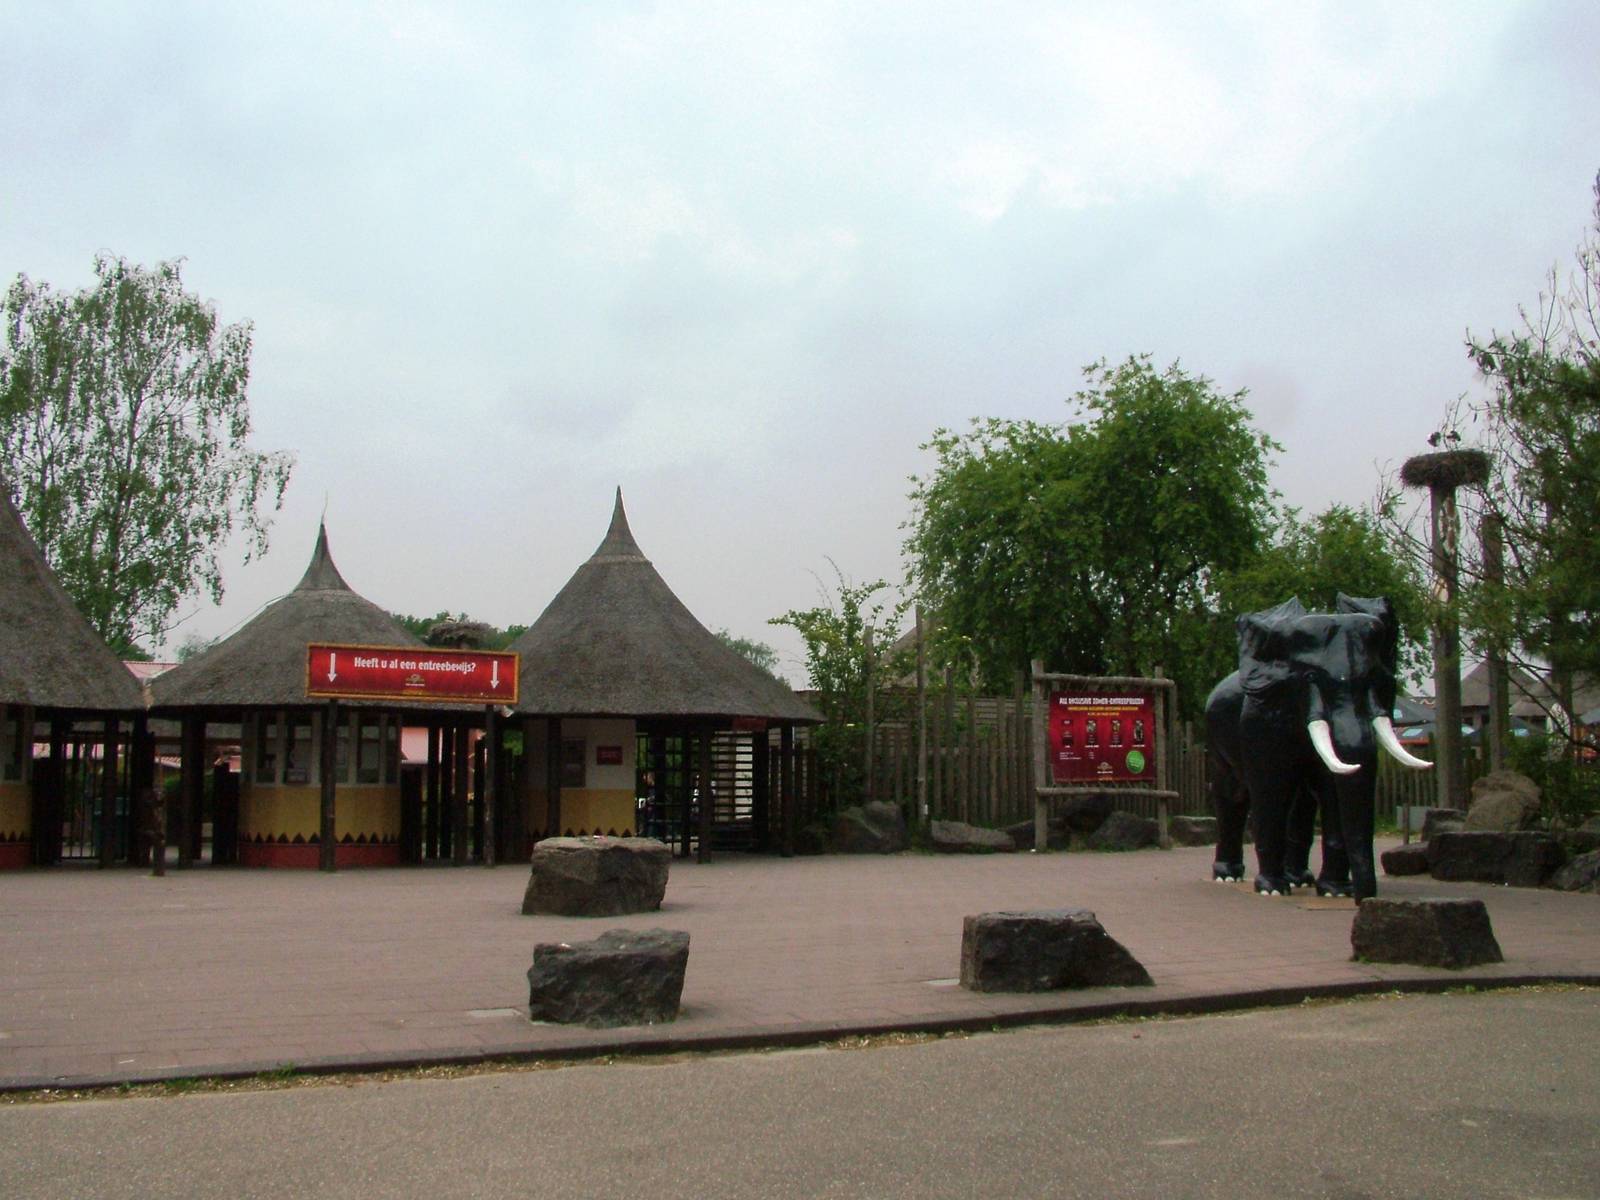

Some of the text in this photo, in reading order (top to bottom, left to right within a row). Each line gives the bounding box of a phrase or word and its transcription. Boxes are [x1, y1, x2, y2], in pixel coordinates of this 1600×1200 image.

[354, 656, 477, 674] Heeft u al een entreebewijs?
